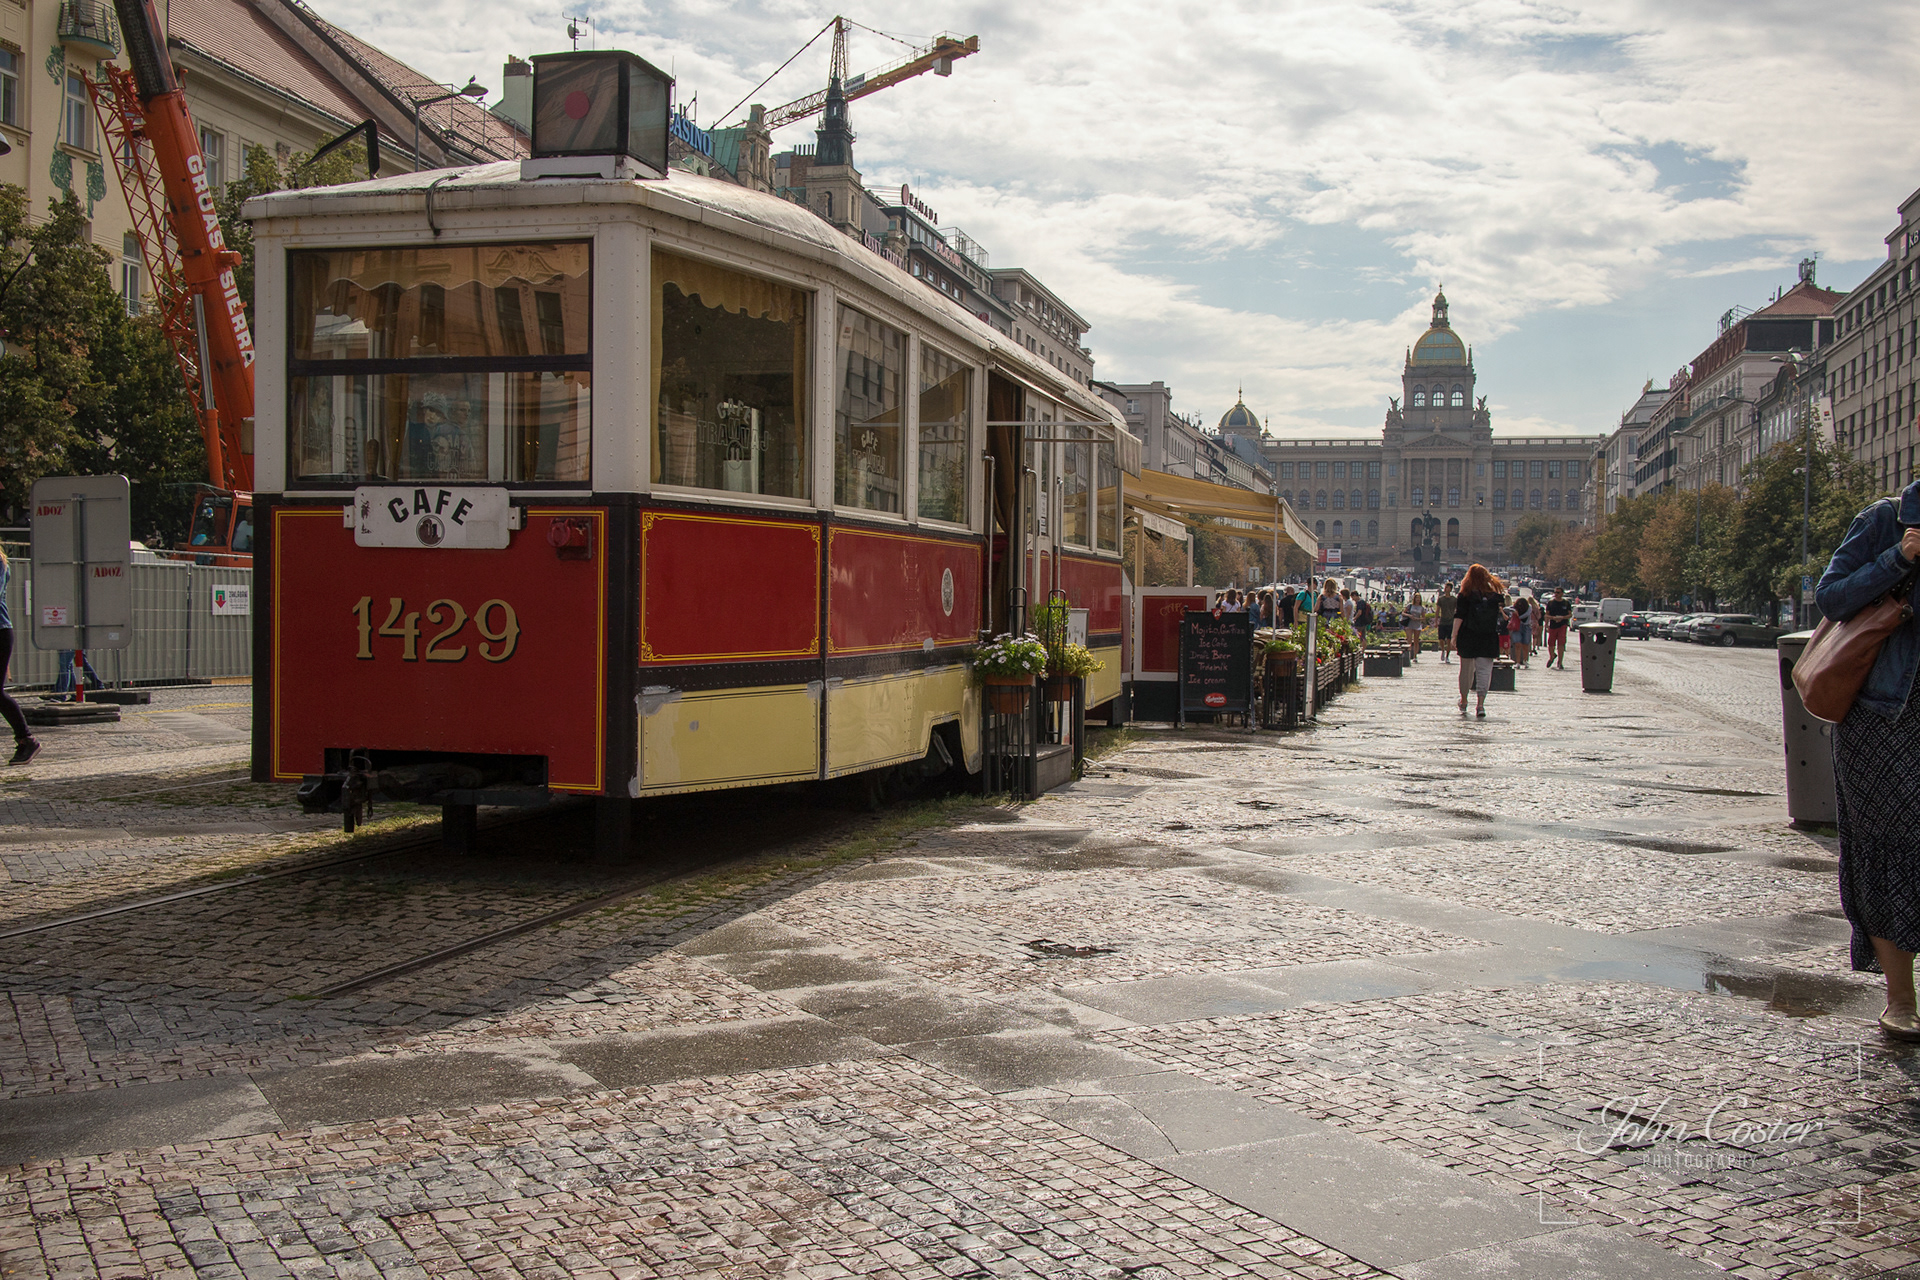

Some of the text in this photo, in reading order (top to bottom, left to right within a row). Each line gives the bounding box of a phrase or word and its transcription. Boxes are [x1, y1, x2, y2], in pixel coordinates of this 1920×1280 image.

[909, 192, 938, 225] RAMADA
[187, 154, 255, 368] GRUAS SIERRA
[36, 505, 63, 516] ADOZ
[388, 489, 474, 526] CAFE
[93, 566, 122, 578] ADOZ
[352, 596, 521, 663] 1429
[1211, 649, 1231, 660] Beer
[1187, 673, 1201, 684] Ice
